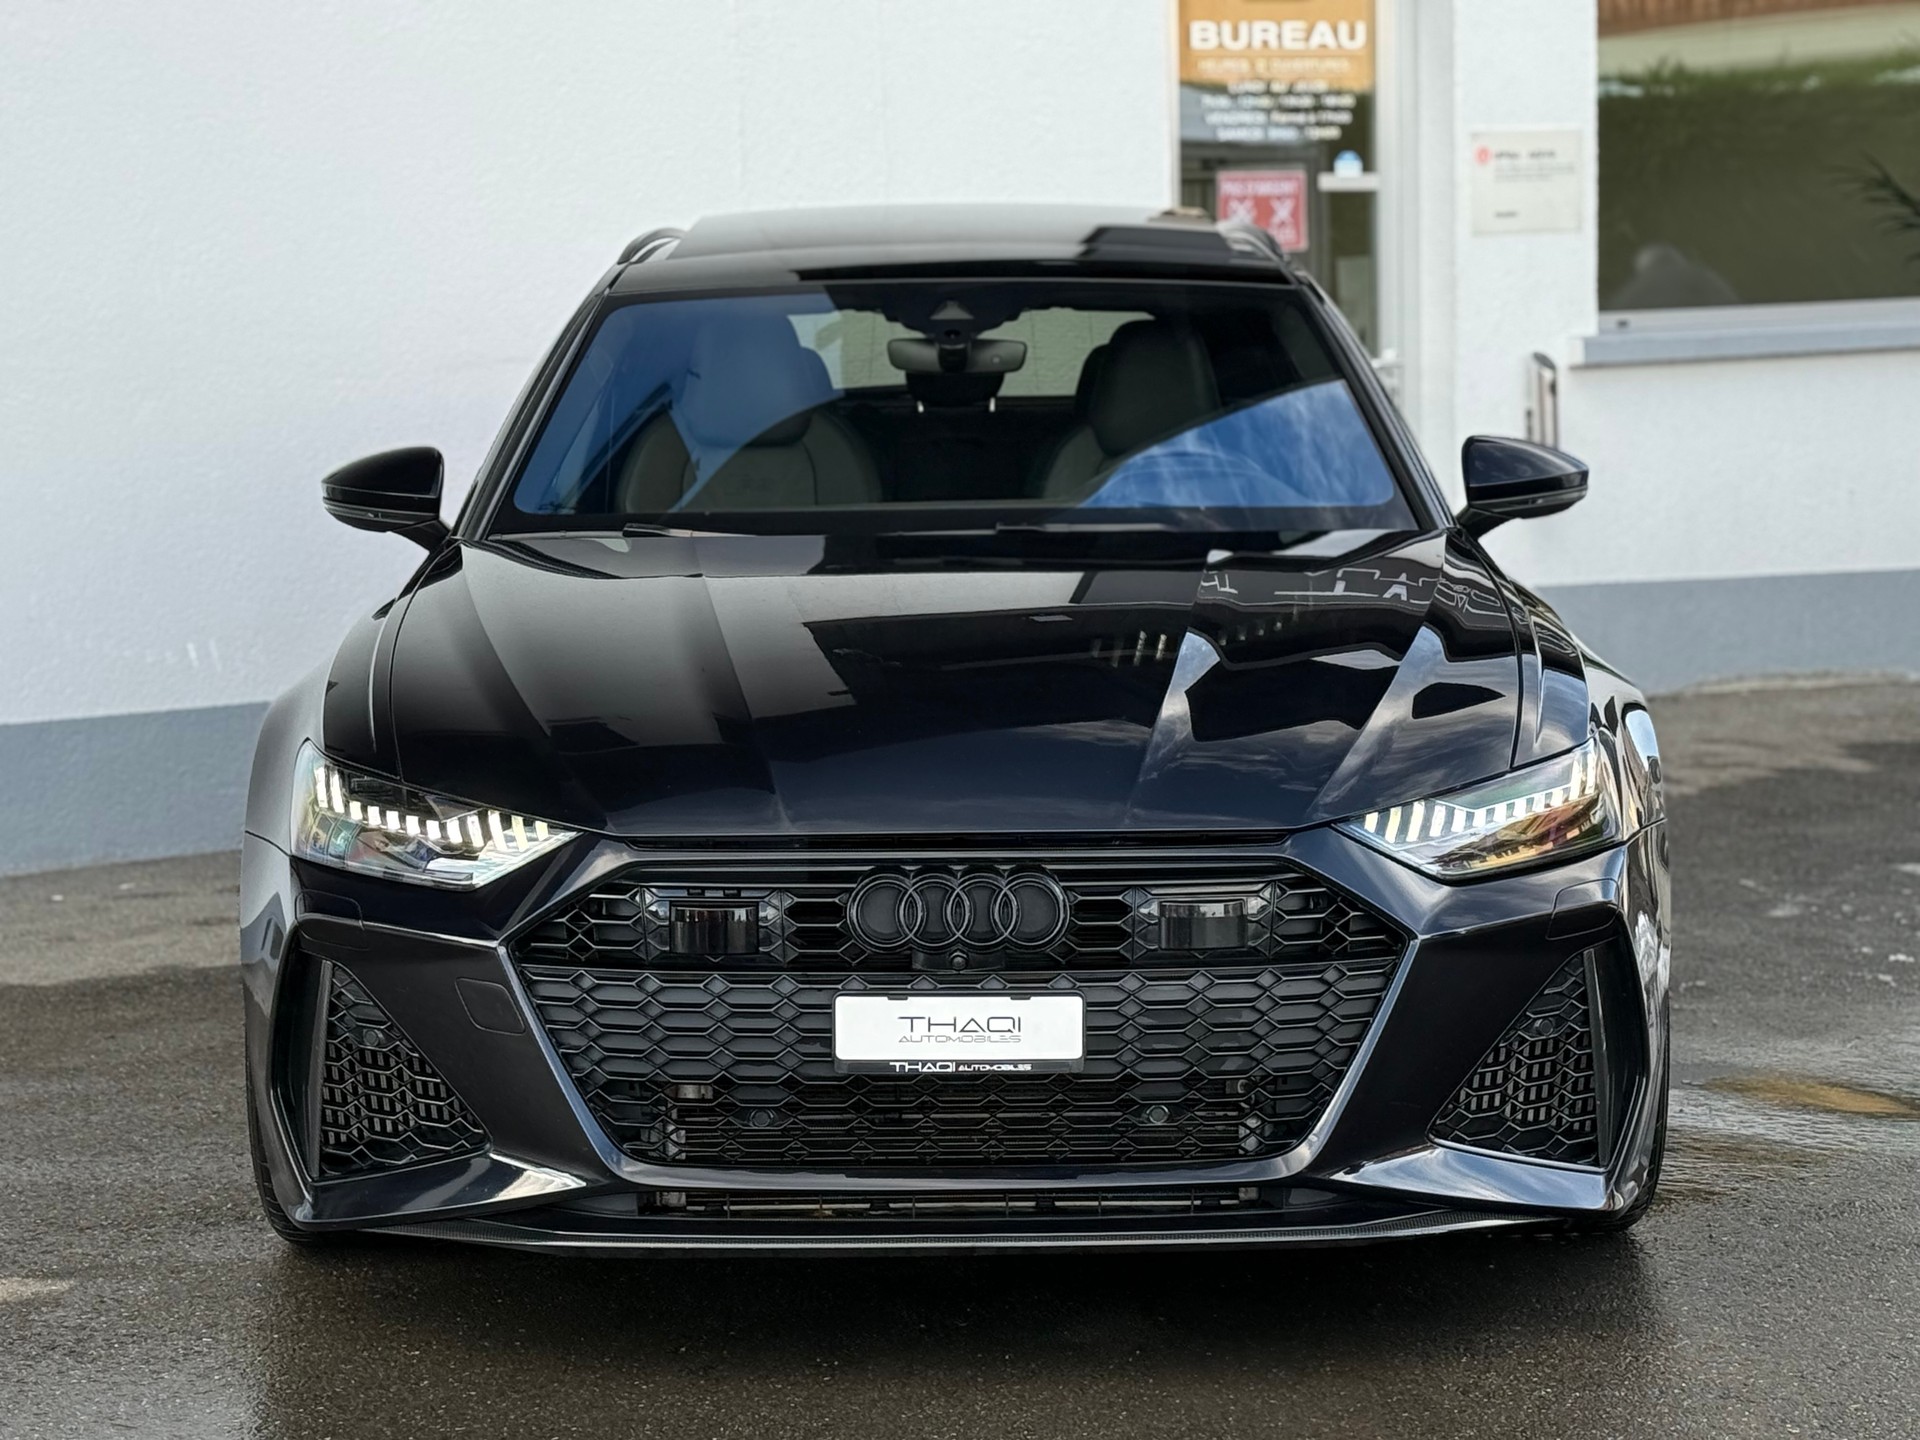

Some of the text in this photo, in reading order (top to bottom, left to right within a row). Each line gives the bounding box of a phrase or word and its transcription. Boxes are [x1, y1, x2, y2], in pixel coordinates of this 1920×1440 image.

[1189, 20, 1367, 50] BUREAU
[897, 1016, 1021, 1034] THAQI
[898, 1035, 1021, 1043] AUTOMOBILES
[889, 1062, 956, 1072] THAQI
